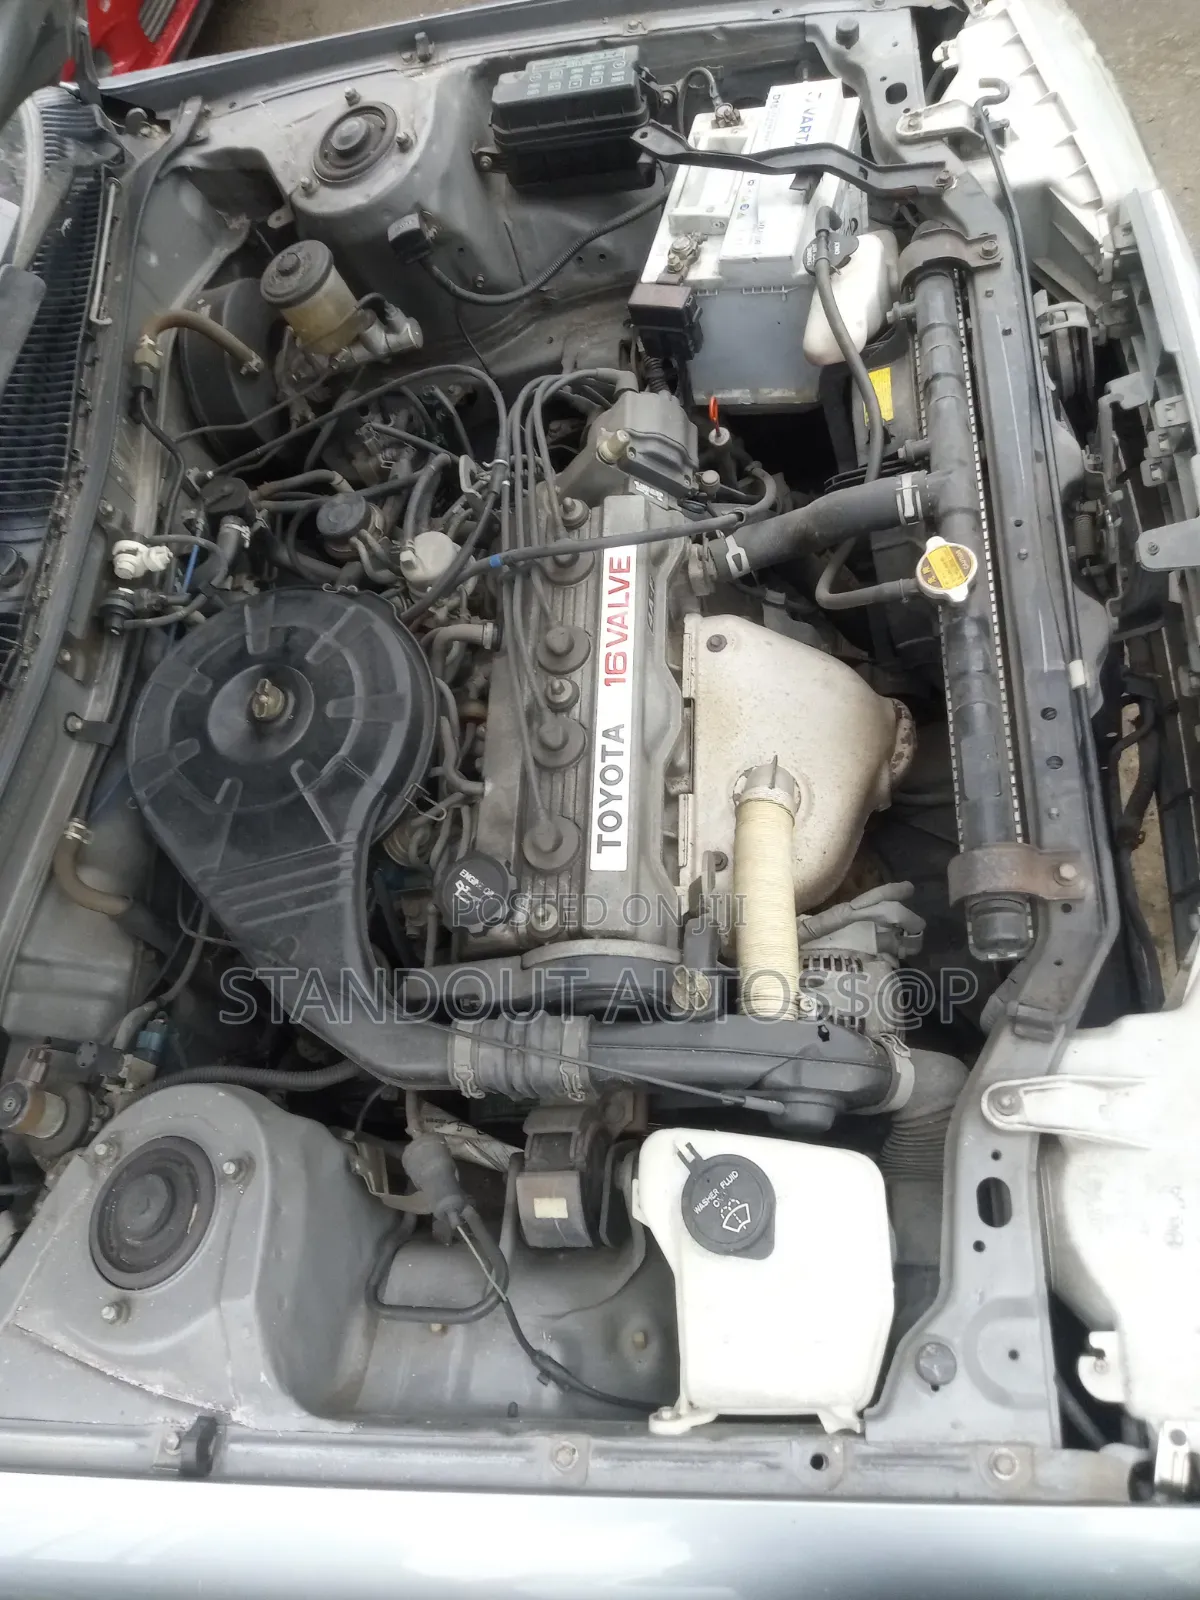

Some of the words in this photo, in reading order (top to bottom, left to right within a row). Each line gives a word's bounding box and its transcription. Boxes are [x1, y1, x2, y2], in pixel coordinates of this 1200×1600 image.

[597, 723, 625, 853] TOYOTA
[693, 1188, 719, 1214] WASHER
[720, 1170, 738, 1189] FLUID
